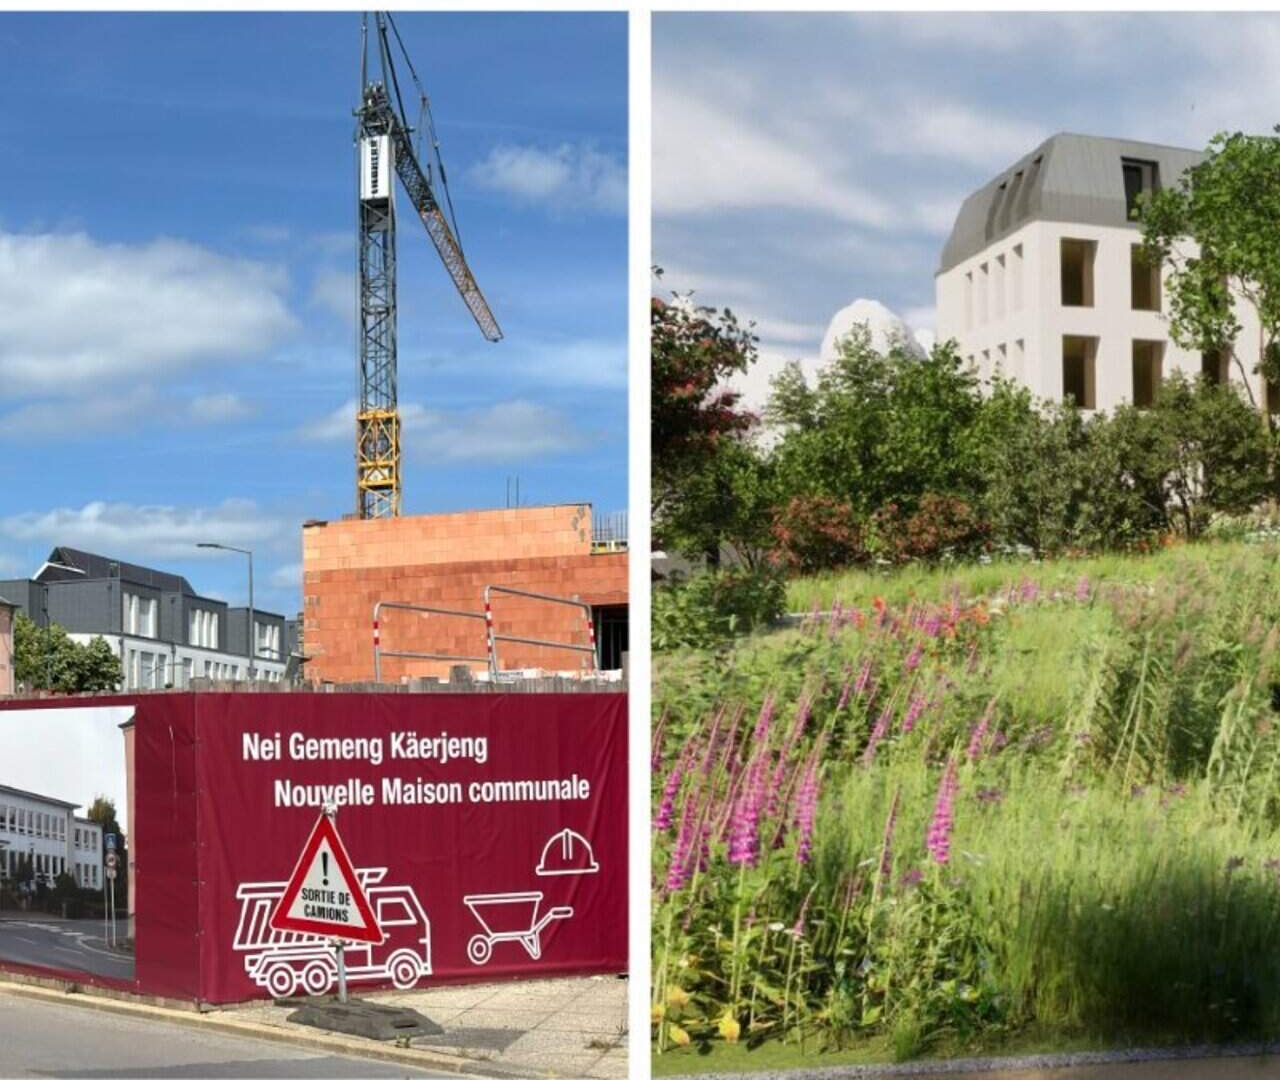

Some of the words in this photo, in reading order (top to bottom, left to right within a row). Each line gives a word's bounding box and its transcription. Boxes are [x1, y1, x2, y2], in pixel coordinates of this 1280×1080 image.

[242, 732, 281, 761] Nei
[288, 732, 383, 765] Gemeng
[390, 731, 488, 764] Käerjeng
[274, 778, 375, 807] Nouvelle
[381, 777, 463, 805] Maison
[468, 774, 590, 803] communale
[302, 887, 336, 905] SORTIE
[338, 891, 351, 906] DE
[304, 903, 349, 922] CAMIONS
